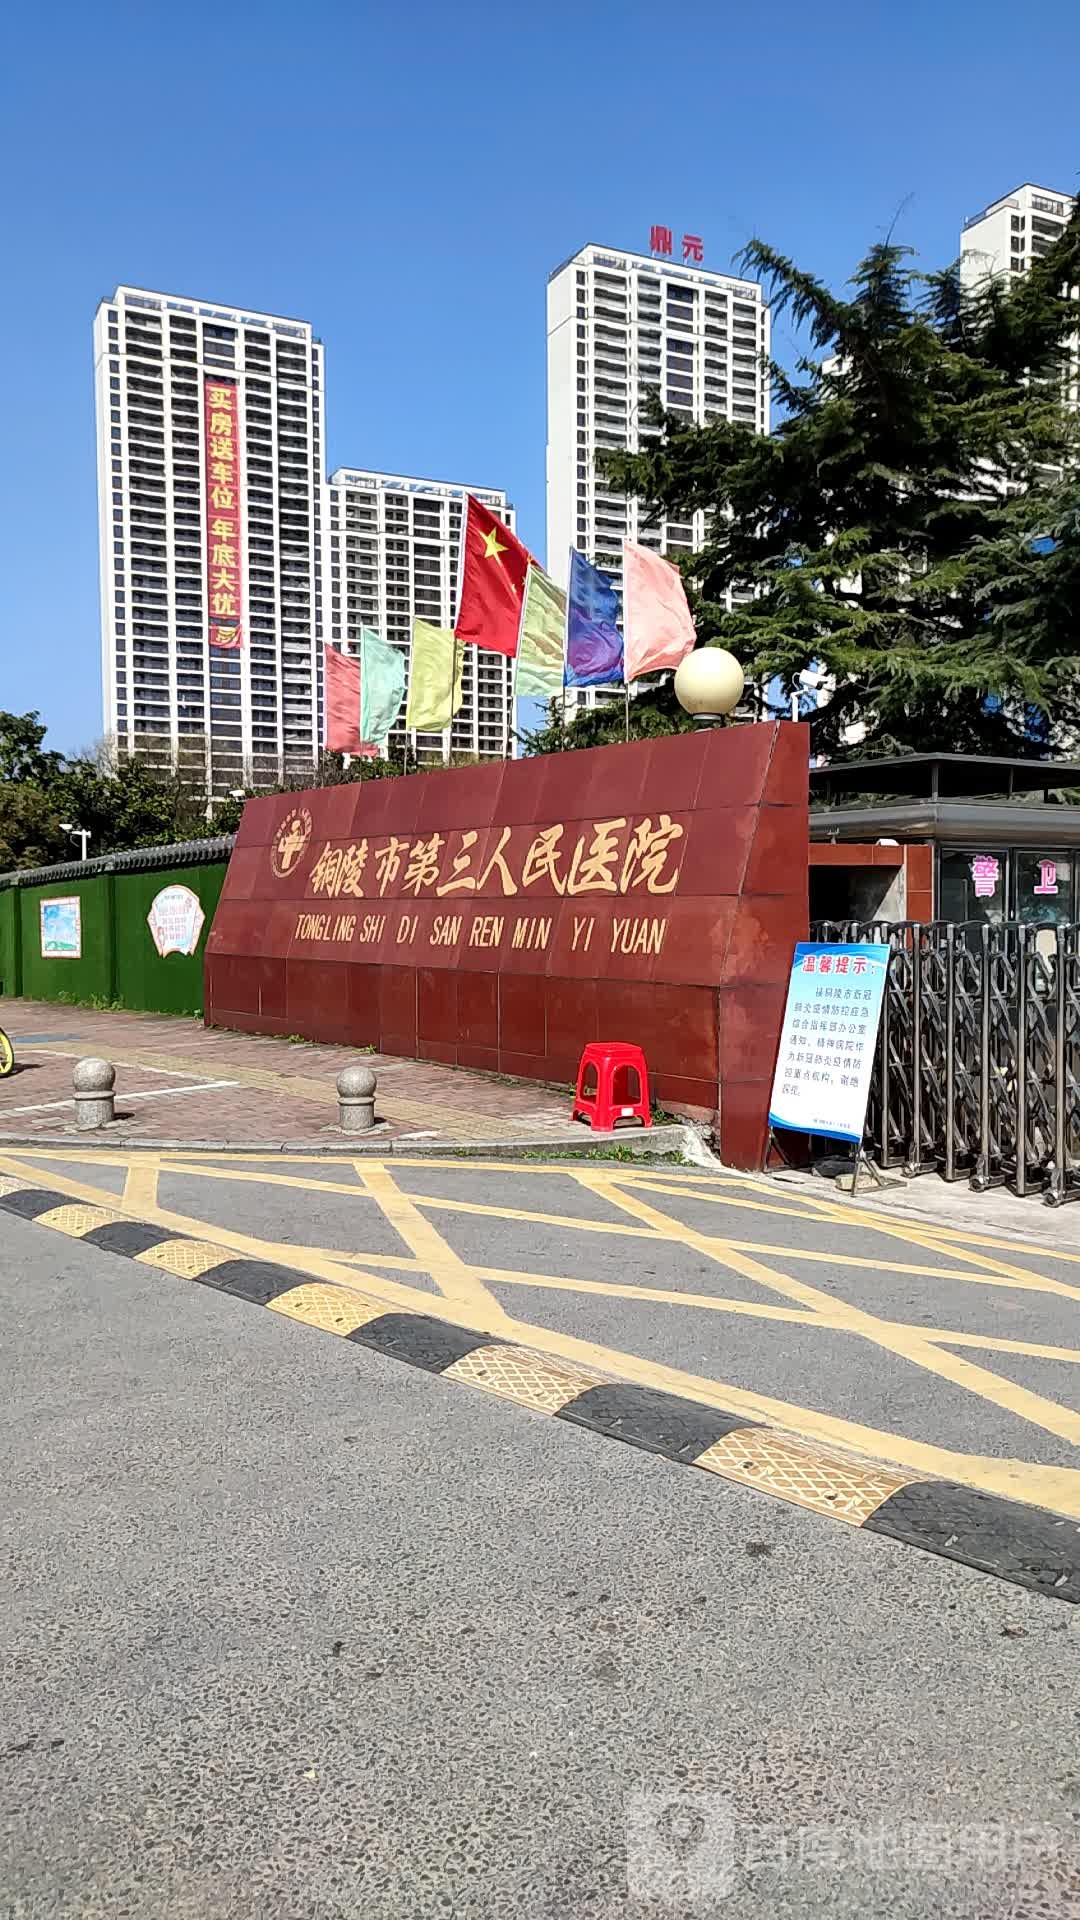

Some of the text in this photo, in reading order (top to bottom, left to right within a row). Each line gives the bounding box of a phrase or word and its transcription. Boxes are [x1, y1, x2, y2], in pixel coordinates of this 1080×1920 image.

[650, 225, 704, 262] 鼎元
[309, 814, 684, 898] 铜陵市第三人民医院
[295, 914, 666, 954] TONGLING SHI DI SAN REN MIN YI YUAN
